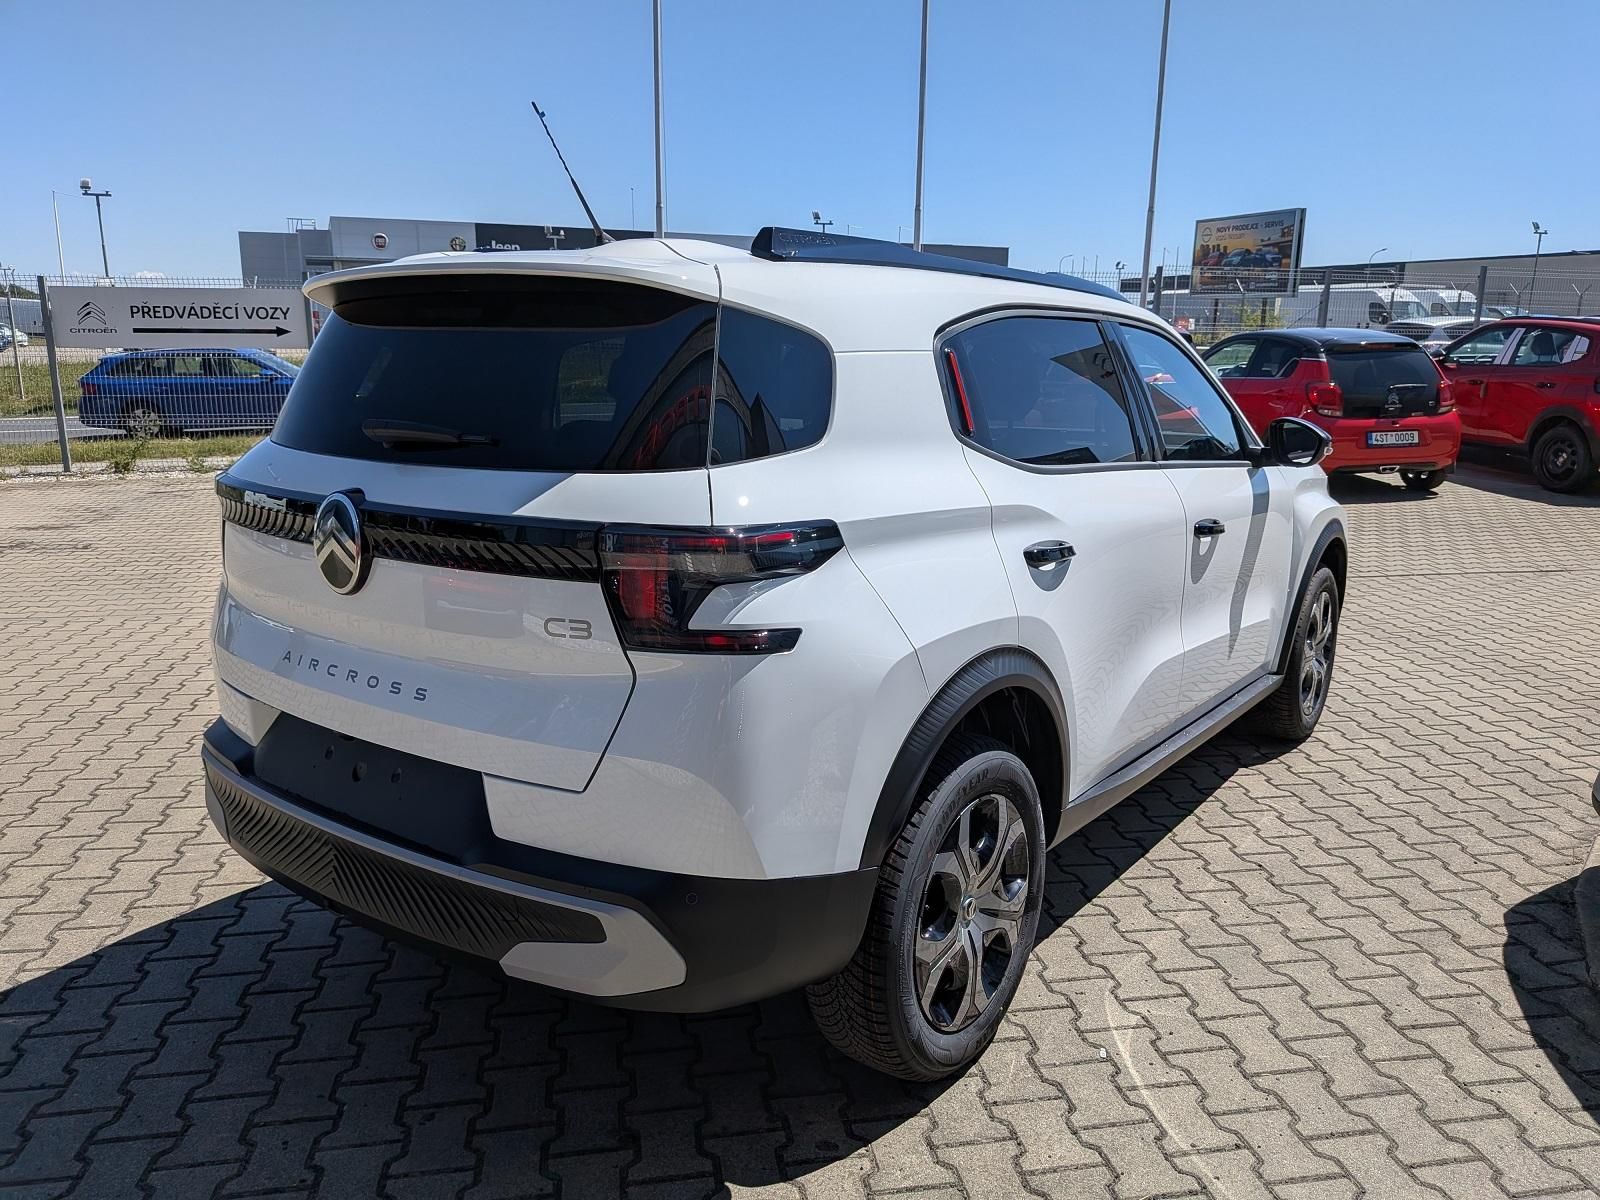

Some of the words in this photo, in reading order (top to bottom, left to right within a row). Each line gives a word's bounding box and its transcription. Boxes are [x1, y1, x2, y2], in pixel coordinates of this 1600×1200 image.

[1264, 220, 1285, 229] SERVIS
[129, 301, 240, 320] PŘEDVÁDĚCÍ
[244, 306, 291, 320] VOZY
[1374, 433, 1389, 443] 4ST
[1394, 432, 1415, 442] 0009
[543, 617, 593, 640] C3
[282, 650, 428, 702] AIRCROSS
